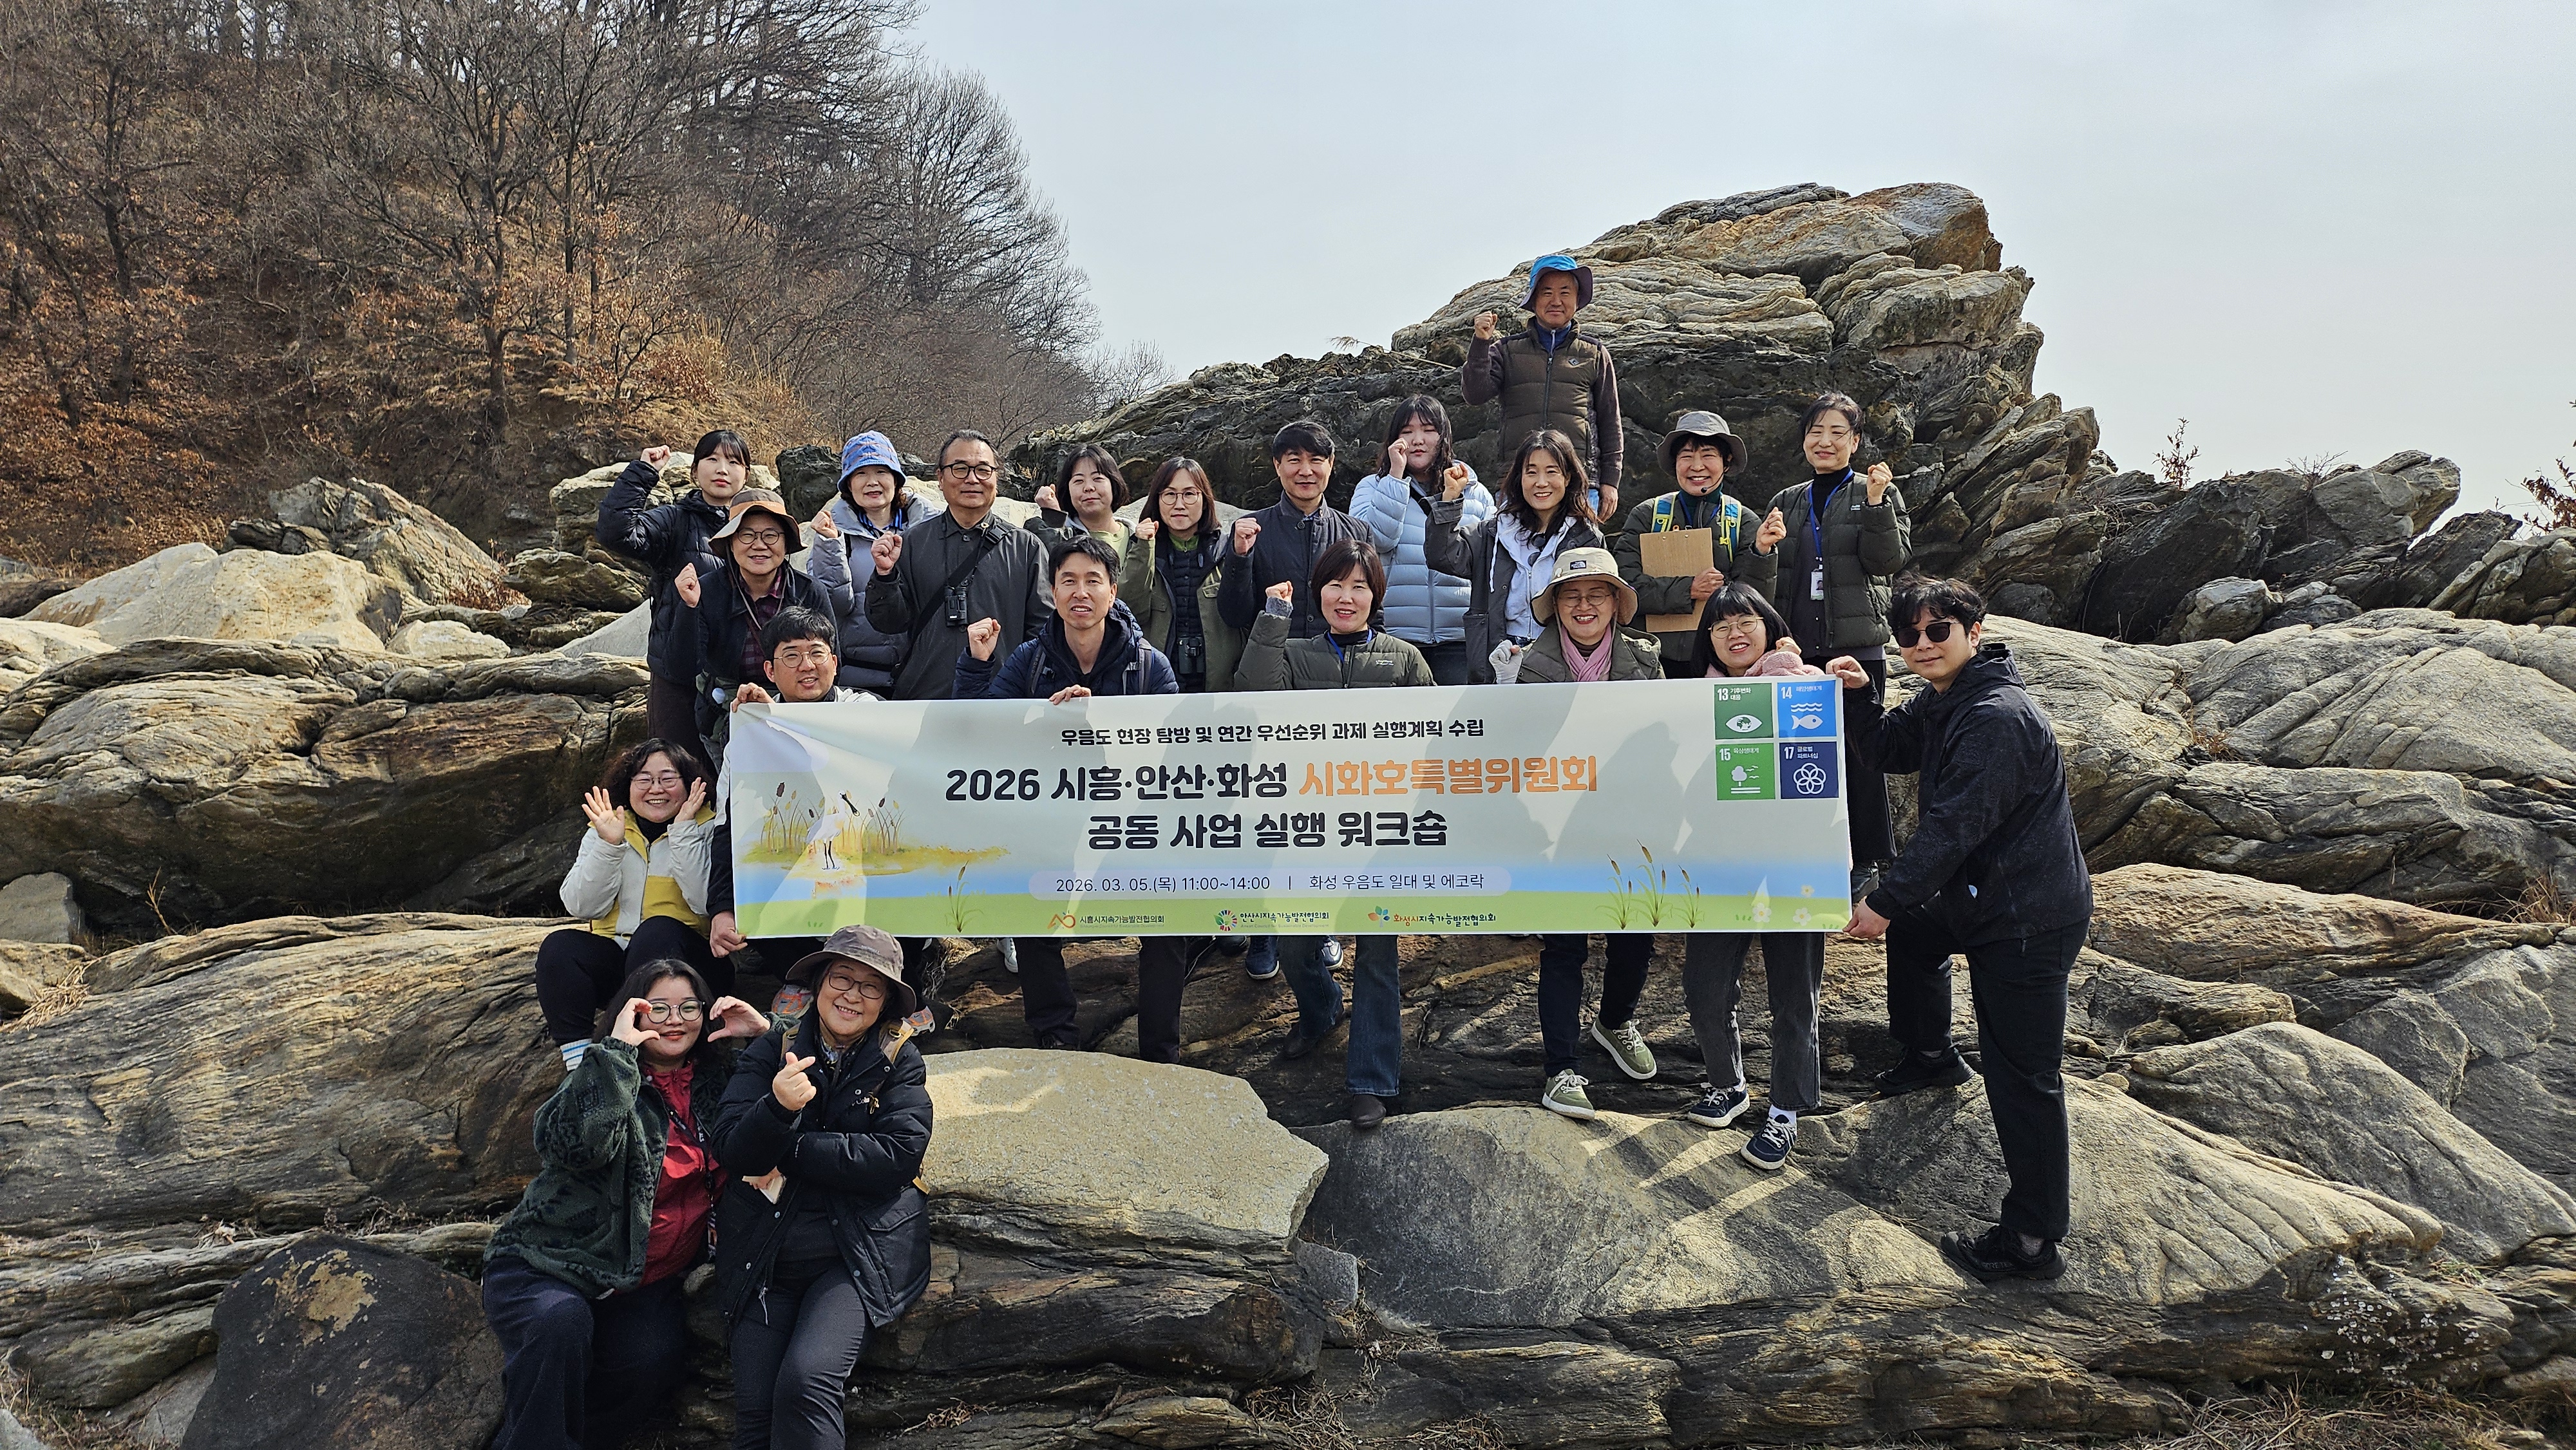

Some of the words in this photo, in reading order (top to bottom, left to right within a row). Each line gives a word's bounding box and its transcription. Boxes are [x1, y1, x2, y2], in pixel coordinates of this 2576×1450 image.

[1717, 688, 1728, 701] 13
[1781, 686, 1792, 699] 14
[1061, 729, 1112, 746] 우음도
[1117, 728, 1151, 745] 현장
[1156, 726, 1190, 744] 탐방
[1196, 726, 1213, 744] 및
[1217, 725, 1252, 742] 연간
[1257, 723, 1327, 742] 우선순위
[1332, 722, 1367, 740] 과제
[1372, 720, 1443, 739] 실행계획
[1448, 719, 1484, 737] 수립
[1719, 748, 1731, 761] 15
[1784, 746, 1794, 759] 17
[945, 768, 1040, 801] 2026
[1051, 763, 1287, 801] 시흥·안산·화성
[1298, 755, 1596, 796] 시화호특별위원회
[1088, 815, 1159, 850] 공동
[1170, 813, 1242, 849] 사업
[1254, 812, 1326, 848] 실행
[1338, 810, 1448, 847] 워크숍
[1056, 879, 1097, 892] 2026.
[1102, 878, 1124, 892] 03.
[1129, 877, 1176, 893] 05.(목)
[1182, 876, 1270, 890] 11:00~14:00
[1309, 874, 1337, 890] 화성
[1341, 874, 1385, 890] 우음도
[1389, 874, 1417, 890] 일대
[1423, 874, 1436, 889] 및
[1441, 873, 1484, 889] 에코락
[1079, 915, 1164, 924] 시흥시지속가능발전협의회
[1240, 912, 1329, 923] 안산시지속가능발전협의회
[1393, 912, 1496, 928] 화성시지속가능발전협의회
